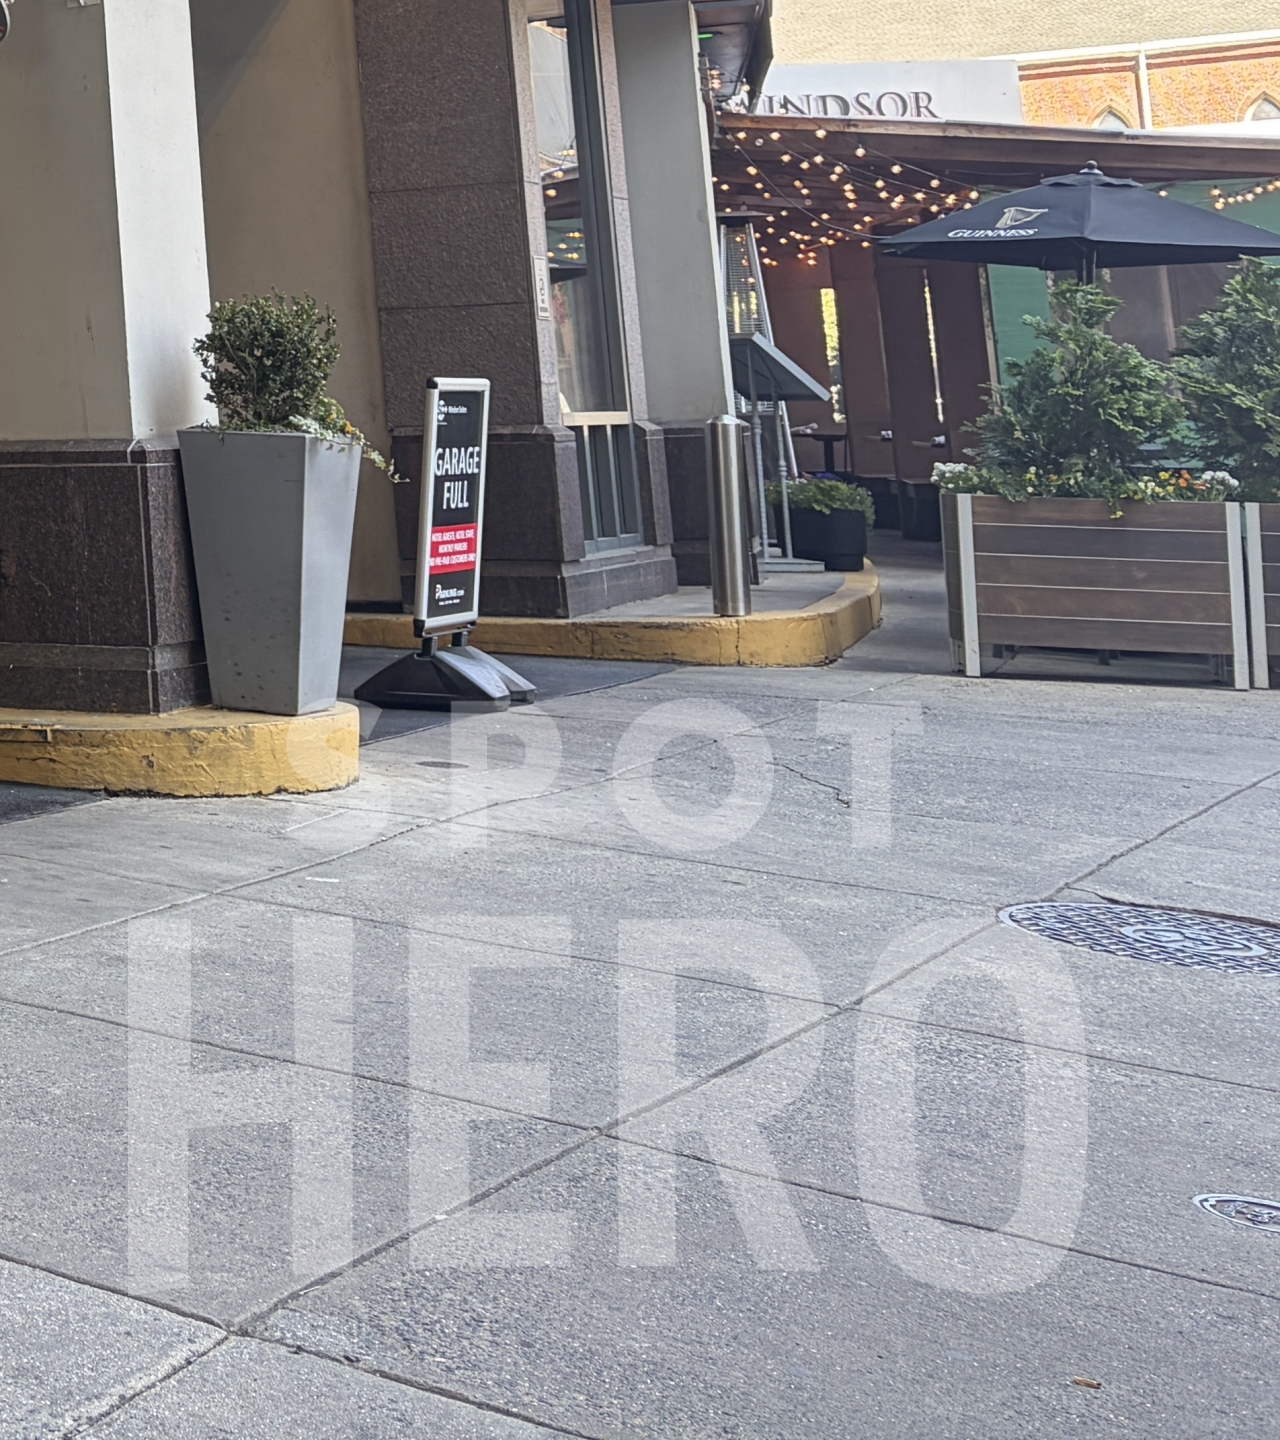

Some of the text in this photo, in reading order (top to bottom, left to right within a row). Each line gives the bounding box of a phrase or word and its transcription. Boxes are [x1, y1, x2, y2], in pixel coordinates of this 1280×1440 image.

[947, 228, 1038, 238] GUINNESS
[434, 446, 480, 476] GARAGE
[442, 480, 469, 510] FULL
